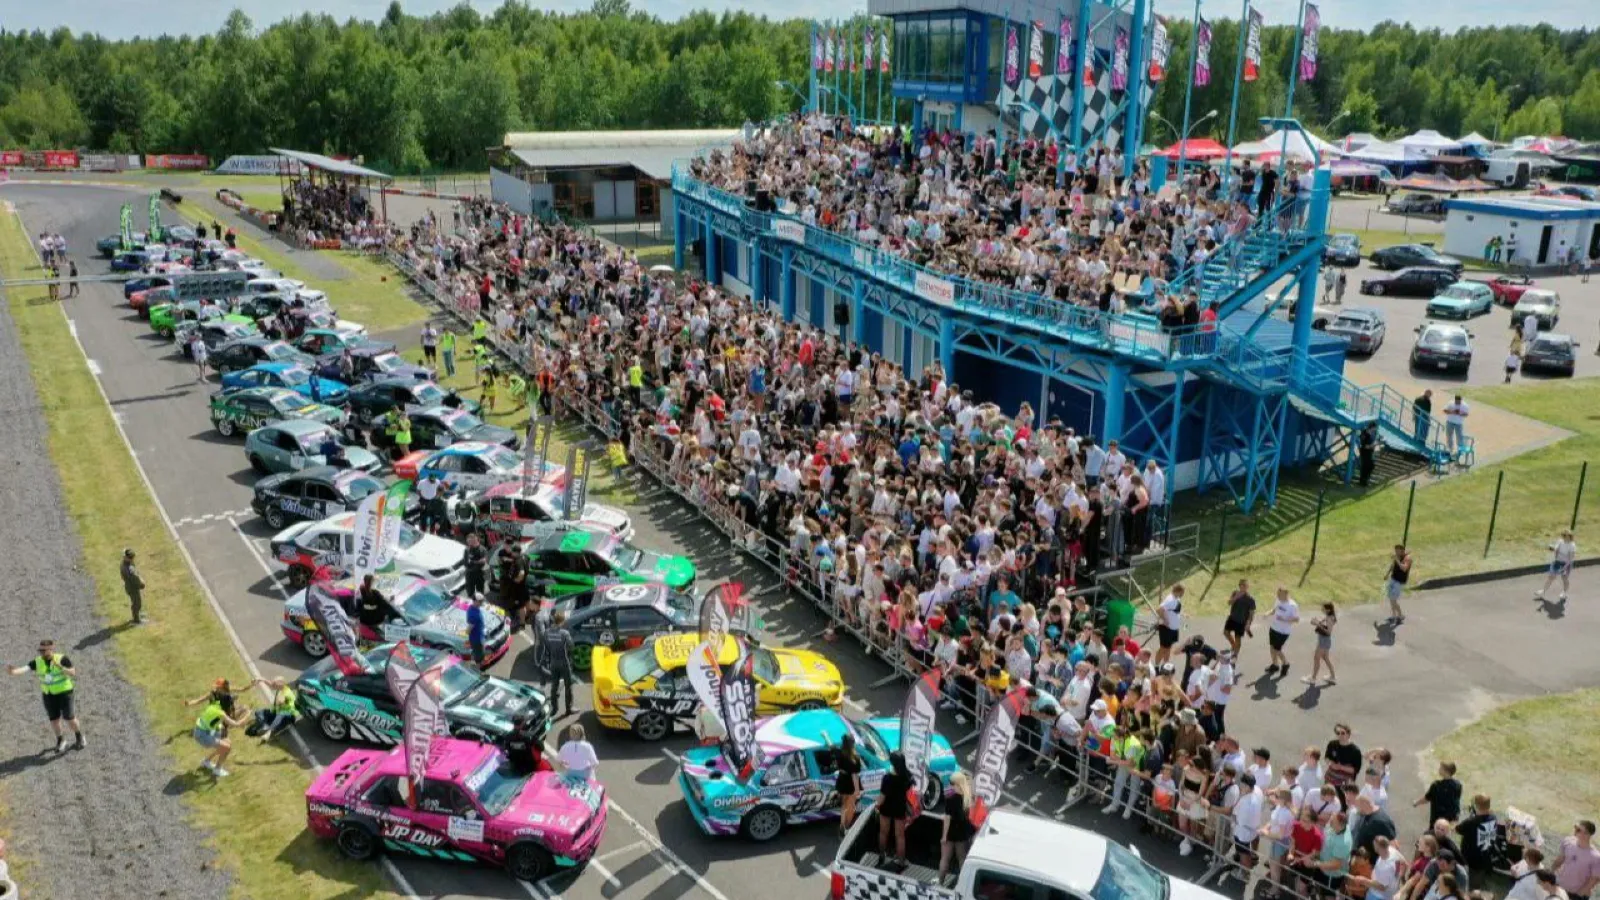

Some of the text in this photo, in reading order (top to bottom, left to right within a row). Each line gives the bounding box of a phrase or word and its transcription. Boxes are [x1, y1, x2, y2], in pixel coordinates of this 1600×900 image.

[356, 510, 377, 568] Divinol
[411, 704, 435, 757] DAY
[908, 705, 930, 754] DAY
[975, 724, 1009, 806] JP DAY
[384, 823, 443, 847] JP DAY
